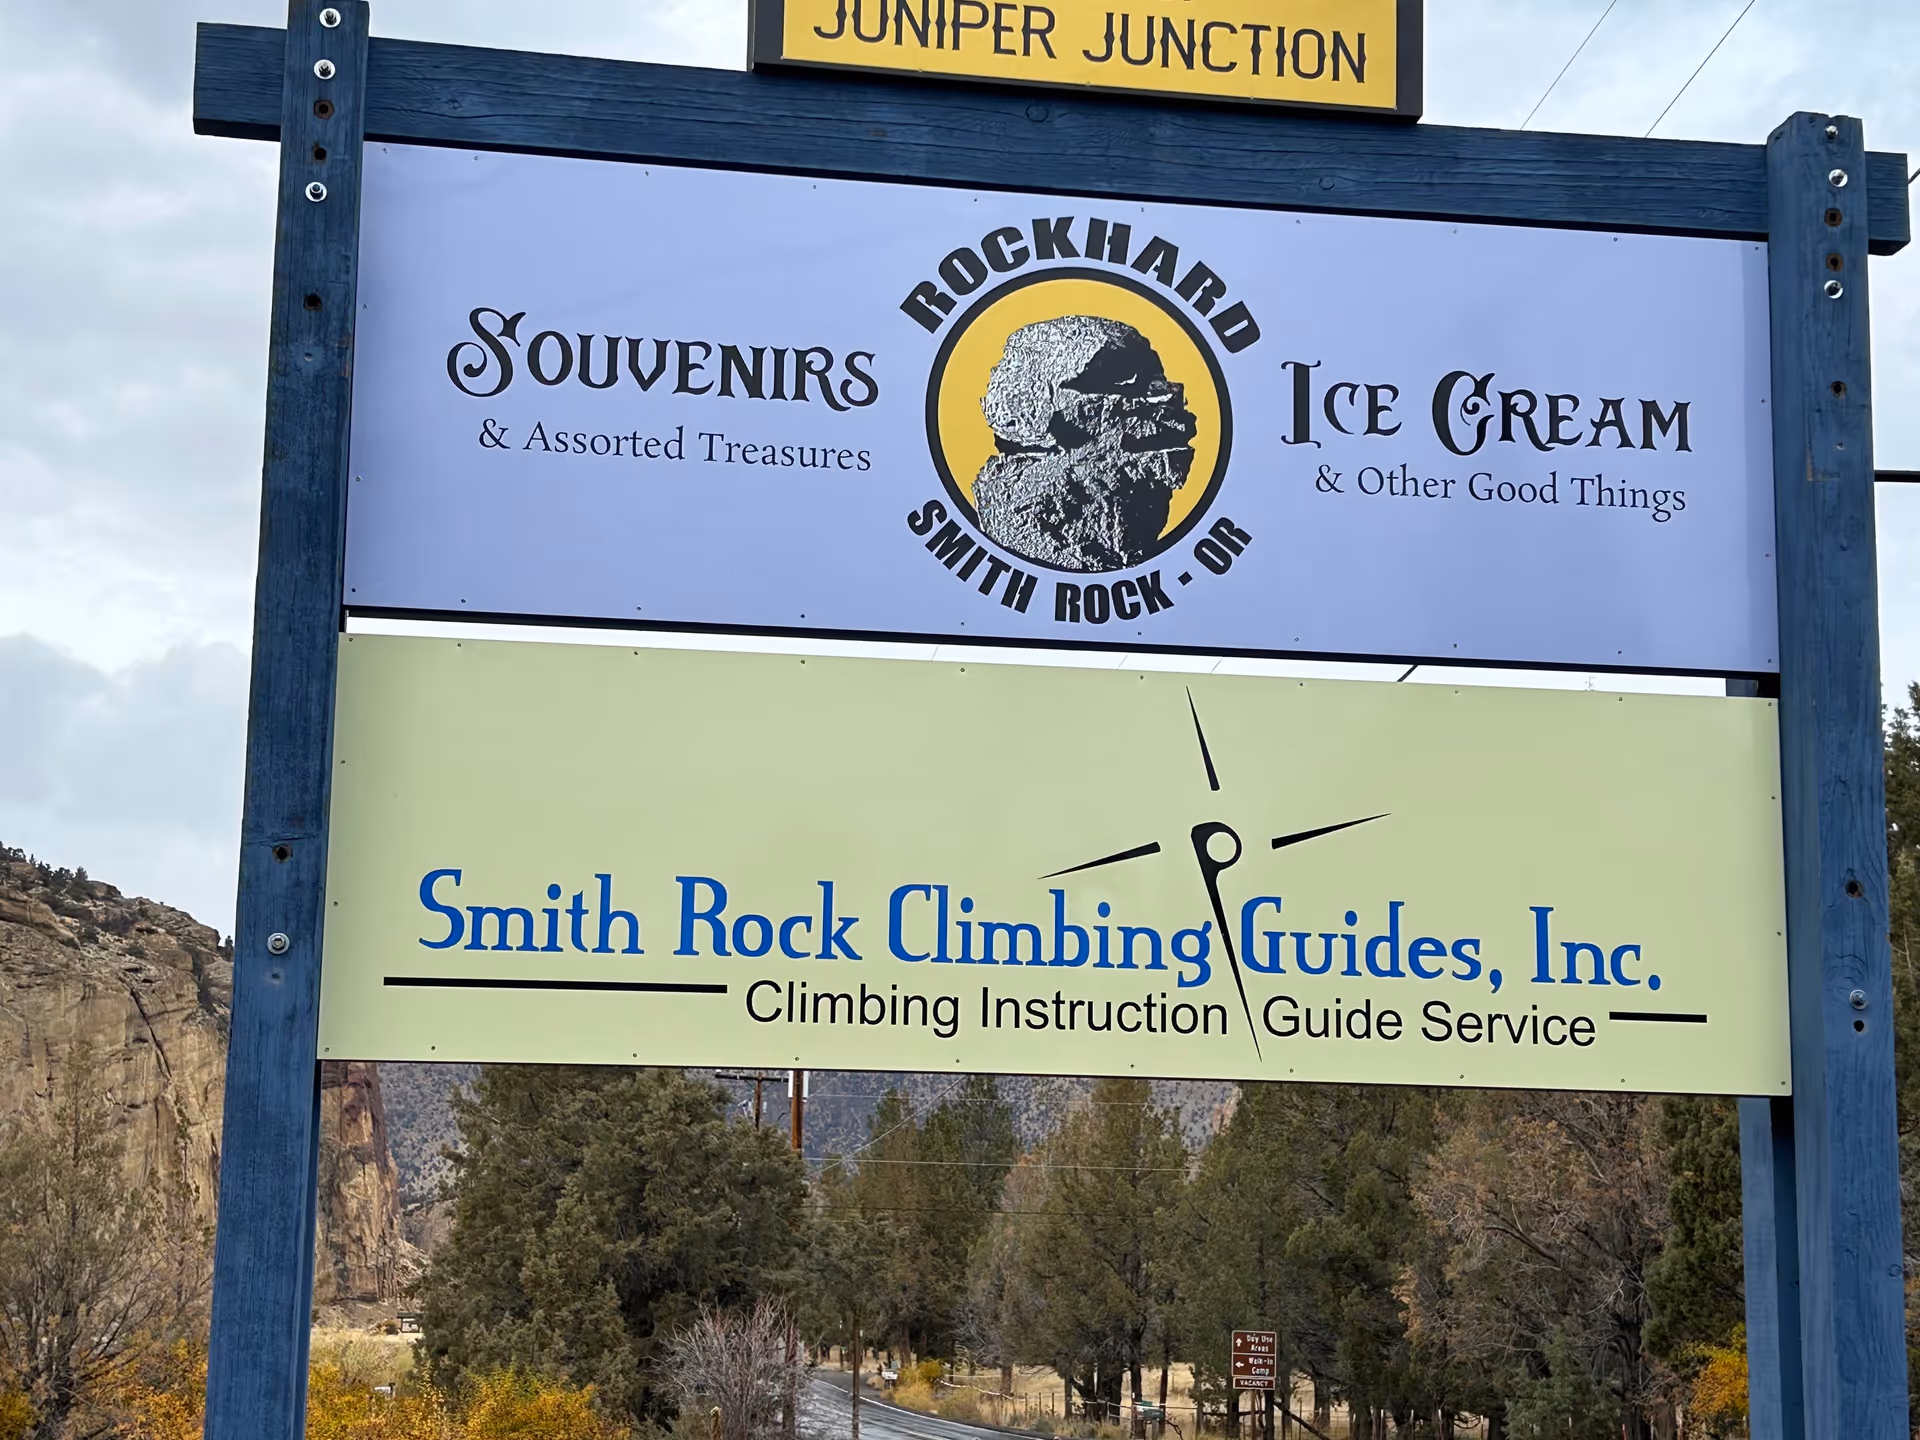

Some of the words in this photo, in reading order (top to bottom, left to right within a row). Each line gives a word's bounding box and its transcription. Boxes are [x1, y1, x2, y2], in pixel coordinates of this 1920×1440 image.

[813, 0, 1057, 59] JUNIPER
[1082, 12, 1367, 84] JUNCTION
[899, 216, 1261, 354] ROCKHARD
[478, 418, 512, 450] &
[522, 420, 686, 461] Assorted
[698, 432, 872, 472] Treasures
[1315, 464, 1345, 494] &
[1357, 463, 1457, 499] Other
[1468, 471, 1560, 505] Good
[1571, 473, 1686, 523] Things
[906, 499, 1039, 615] SMITH
[1054, 569, 1175, 625] ROCK
[1193, 516, 1253, 576] OR
[419, 868, 644, 955] Smith
[674, 875, 862, 961] Rock
[888, 884, 1212, 988] Climbing
[1240, 896, 1503, 990] Guides,
[1530, 906, 1662, 991] Inc.
[746, 979, 959, 1039] Climbing
[981, 986, 1227, 1035] Instruction
[1262, 995, 1403, 1041] Guide
[1421, 1000, 1596, 1047] Service
[1246, 1334, 1259, 1343] Day
[1261, 1335, 1273, 1343] Use
[1250, 1344, 1269, 1352] Areas
[1251, 1366, 1270, 1376] Camp
